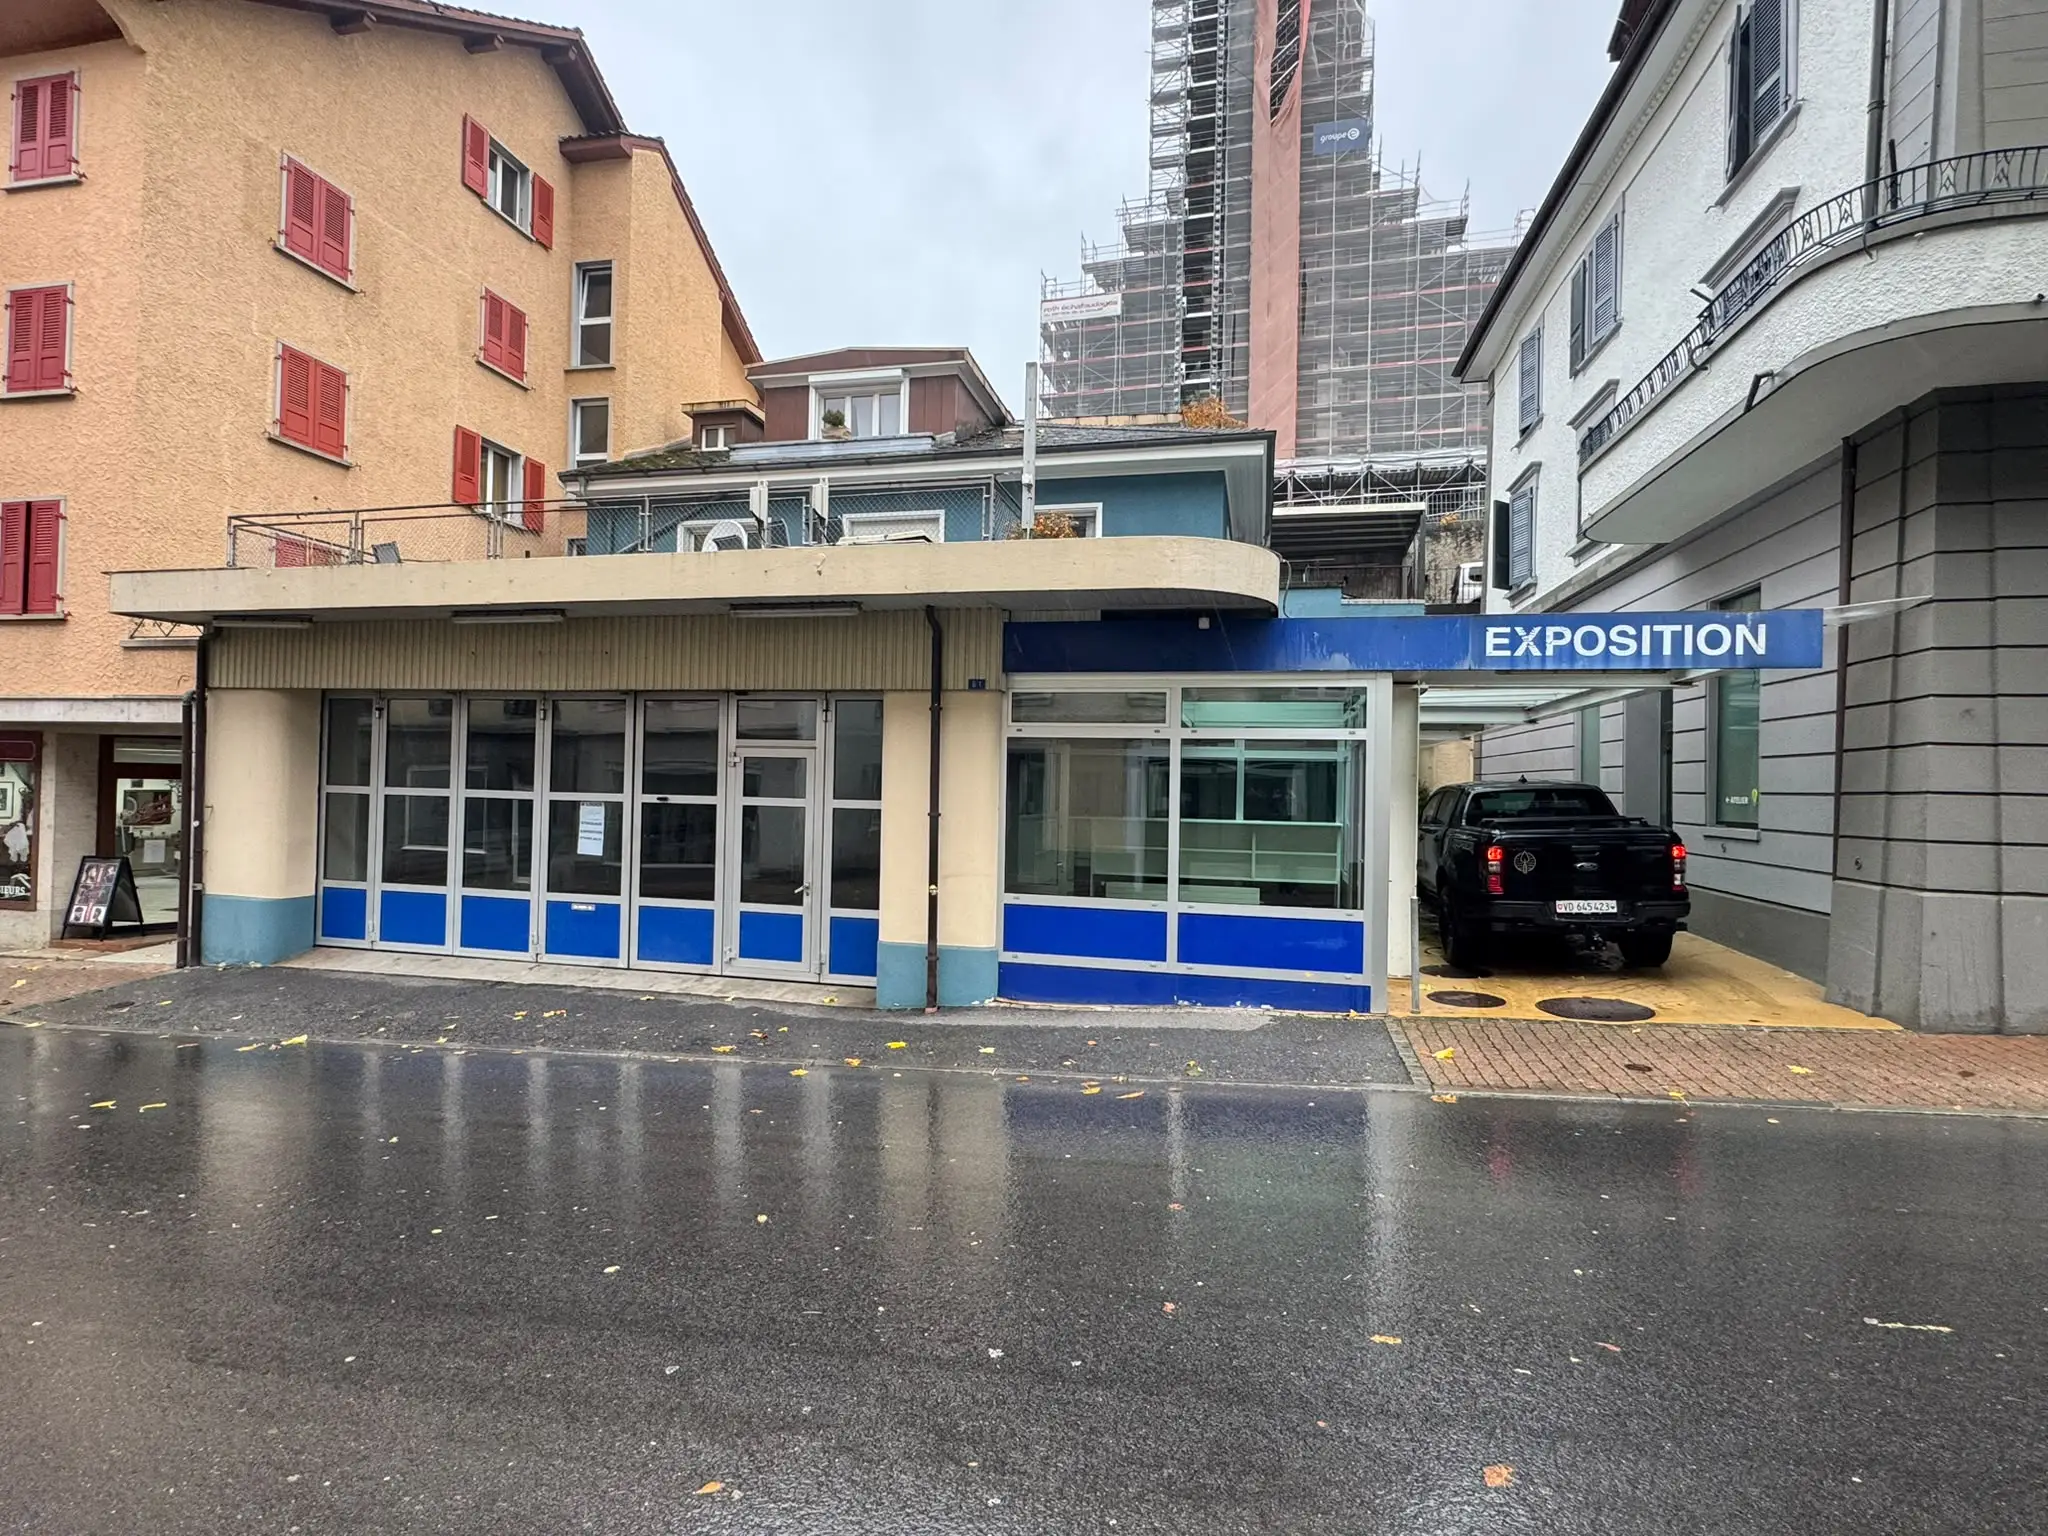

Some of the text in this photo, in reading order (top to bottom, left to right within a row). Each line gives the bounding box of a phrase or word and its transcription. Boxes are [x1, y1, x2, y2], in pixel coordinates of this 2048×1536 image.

[1320, 131, 1347, 144] groupe
[1485, 623, 1767, 657] EXPOSITION
[1563, 902, 1574, 911] VD
